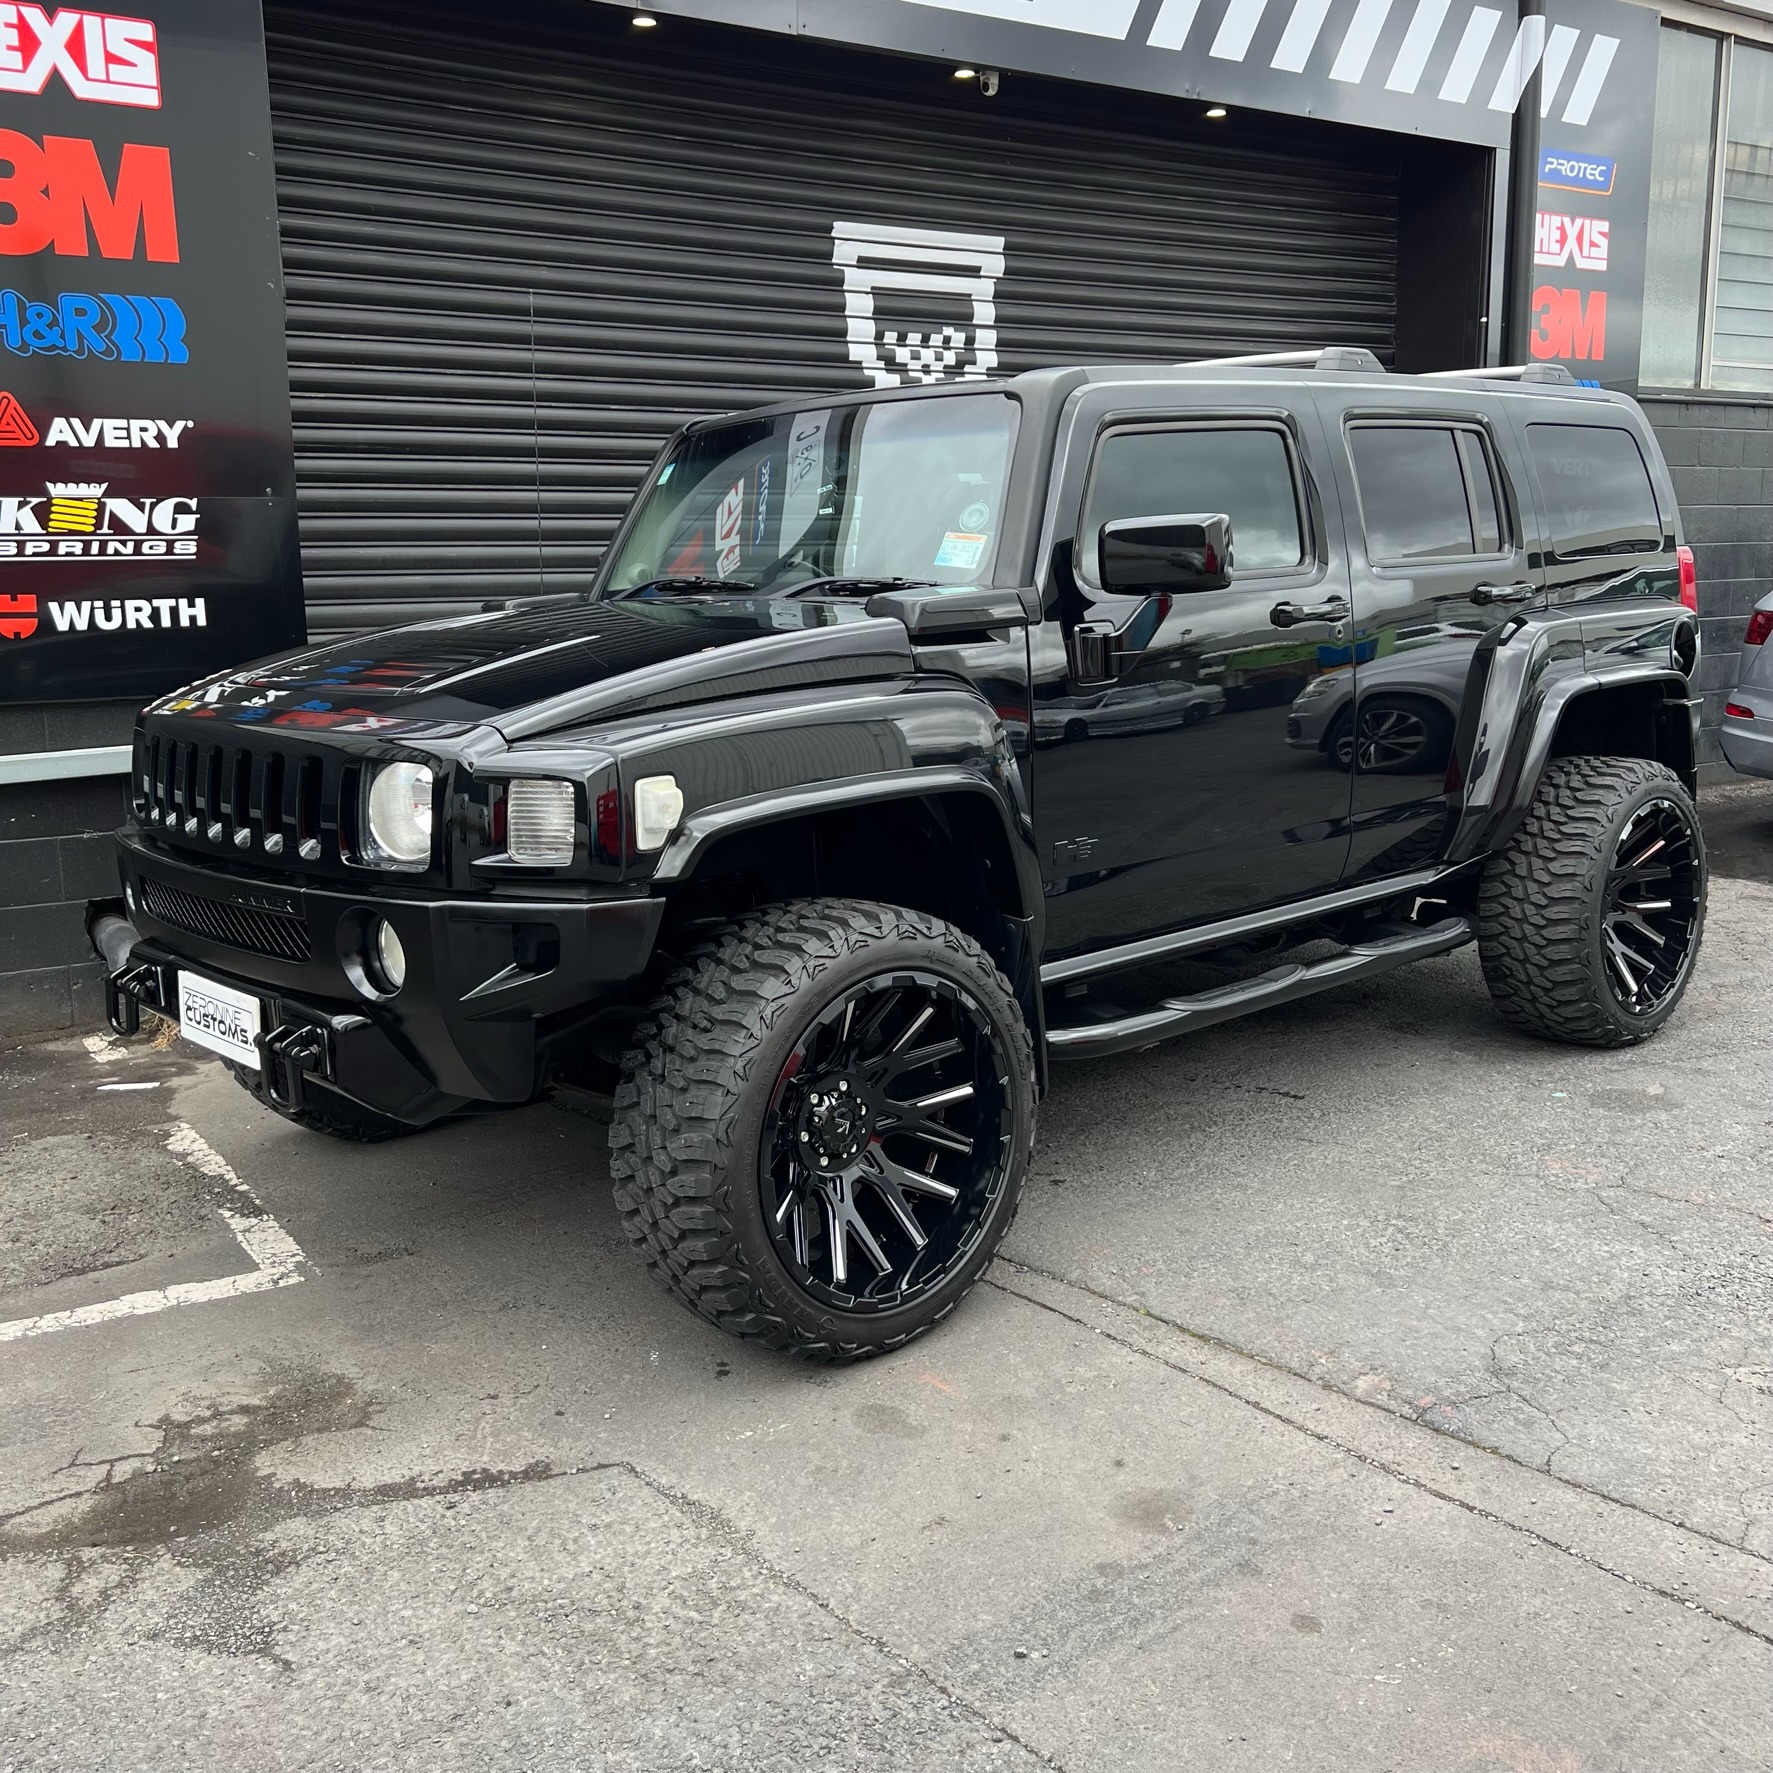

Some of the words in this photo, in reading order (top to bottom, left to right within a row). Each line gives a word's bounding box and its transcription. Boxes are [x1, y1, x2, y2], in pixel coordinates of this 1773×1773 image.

[0, 2, 159, 107] EXIS
[1544, 157, 1607, 181] PROTEC
[0, 128, 180, 263] 3M
[1534, 213, 1609, 271] HEXIS
[1530, 285, 1607, 360] 3M
[45, 417, 187, 449] AVERY
[0, 540, 197, 556] SPRINGS
[47, 597, 207, 632] WÜRTH
[184, 991, 242, 1028] ZERONINE
